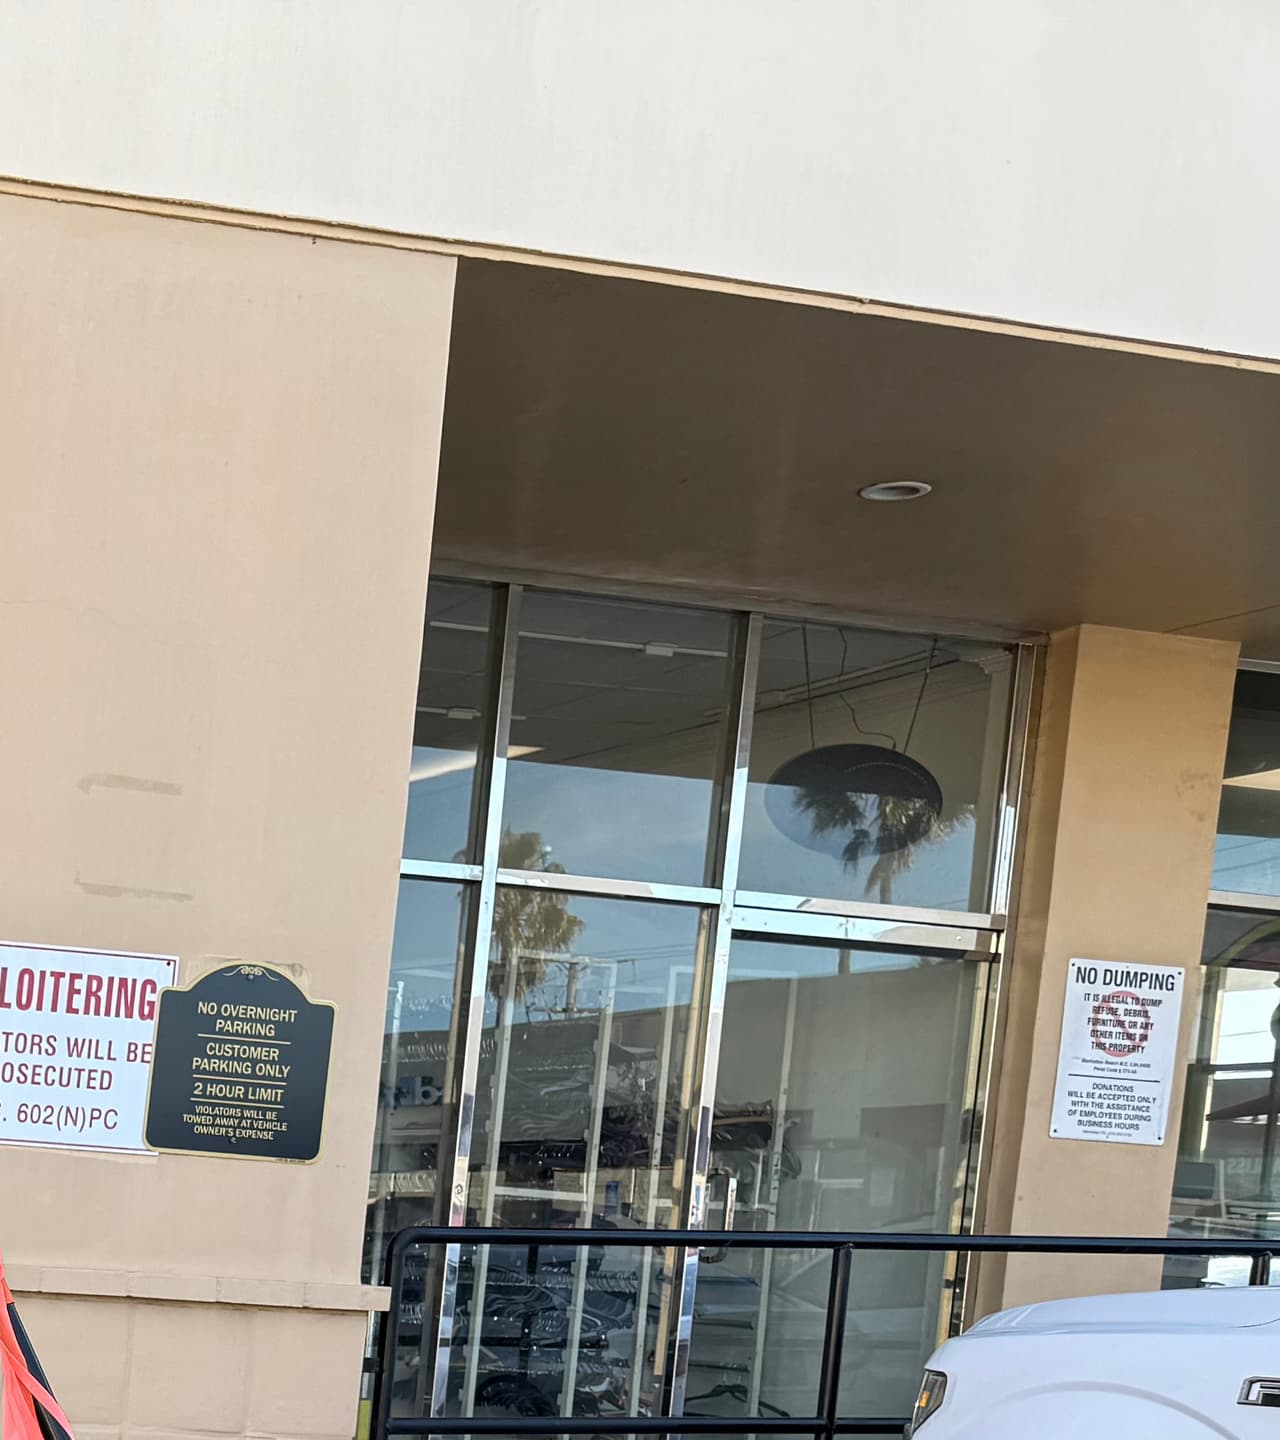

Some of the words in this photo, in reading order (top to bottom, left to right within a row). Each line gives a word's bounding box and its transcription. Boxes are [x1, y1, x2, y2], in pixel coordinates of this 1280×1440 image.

[1075, 966, 1098, 985] NO
[1102, 968, 1176, 991] DUMPING
[1084, 993, 1092, 1001] IT
[1093, 993, 1100, 1002] IS
[1101, 994, 1129, 1005] ILLEGAL
[1131, 996, 1140, 1006] TO
[1141, 998, 1163, 1008] DUMP
[197, 1001, 218, 1015] NO
[221, 1003, 298, 1023] OVERNIGHT
[215, 1019, 276, 1037] PARKING
[1087, 1017, 1127, 1029] FURNITURE
[1139, 1022, 1155, 1030] ANY
[1090, 1029, 1113, 1039] OTHER
[1115, 1031, 1137, 1042] ITEMS
[66, 1037, 118, 1061] WILL
[126, 1042, 153, 1064] BE
[206, 1042, 280, 1061] CUSTOMER
[1091, 1041, 1107, 1051] THIS
[1108, 1042, 1146, 1054] PROPERTY
[192, 1057, 252, 1075] PARKING
[255, 1063, 291, 1078] ONLY
[193, 1082, 203, 1095] 2
[206, 1083, 245, 1099] HOUR
[248, 1087, 285, 1102] LIMIT
[1092, 1082, 1134, 1092] DONATIONS
[1067, 1090, 1084, 1098] WILL
[1086, 1091, 1096, 1099] BE
[1097, 1093, 1136, 1102] ACCEPTED
[1137, 1095, 1157, 1104] ONLY
[195, 1105, 241, 1117] VIOLATORS
[243, 1109, 264, 1119] WILL
[266, 1111, 278, 1120] BE
[1071, 1100, 1089, 1108] WITH
[1091, 1101, 1105, 1109] THE
[1106, 1103, 1151, 1113] ASSISTANCE
[17, 1103, 119, 1133] 602(N)PC
[182, 1113, 213, 1124] TOWED
[214, 1116, 239, 1127] AWAY
[240, 1119, 251, 1128] AT
[253, 1120, 289, 1131] VEHICLE
[1079, 1110, 1122, 1120] EMPLOYEES
[1124, 1113, 1151, 1122] DURING
[193, 1125, 234, 1137] OWNER'S
[236, 1128, 275, 1140] EXPENSE
[1077, 1119, 1113, 1129] BUSINESS
[1114, 1122, 1140, 1131] HOURS
